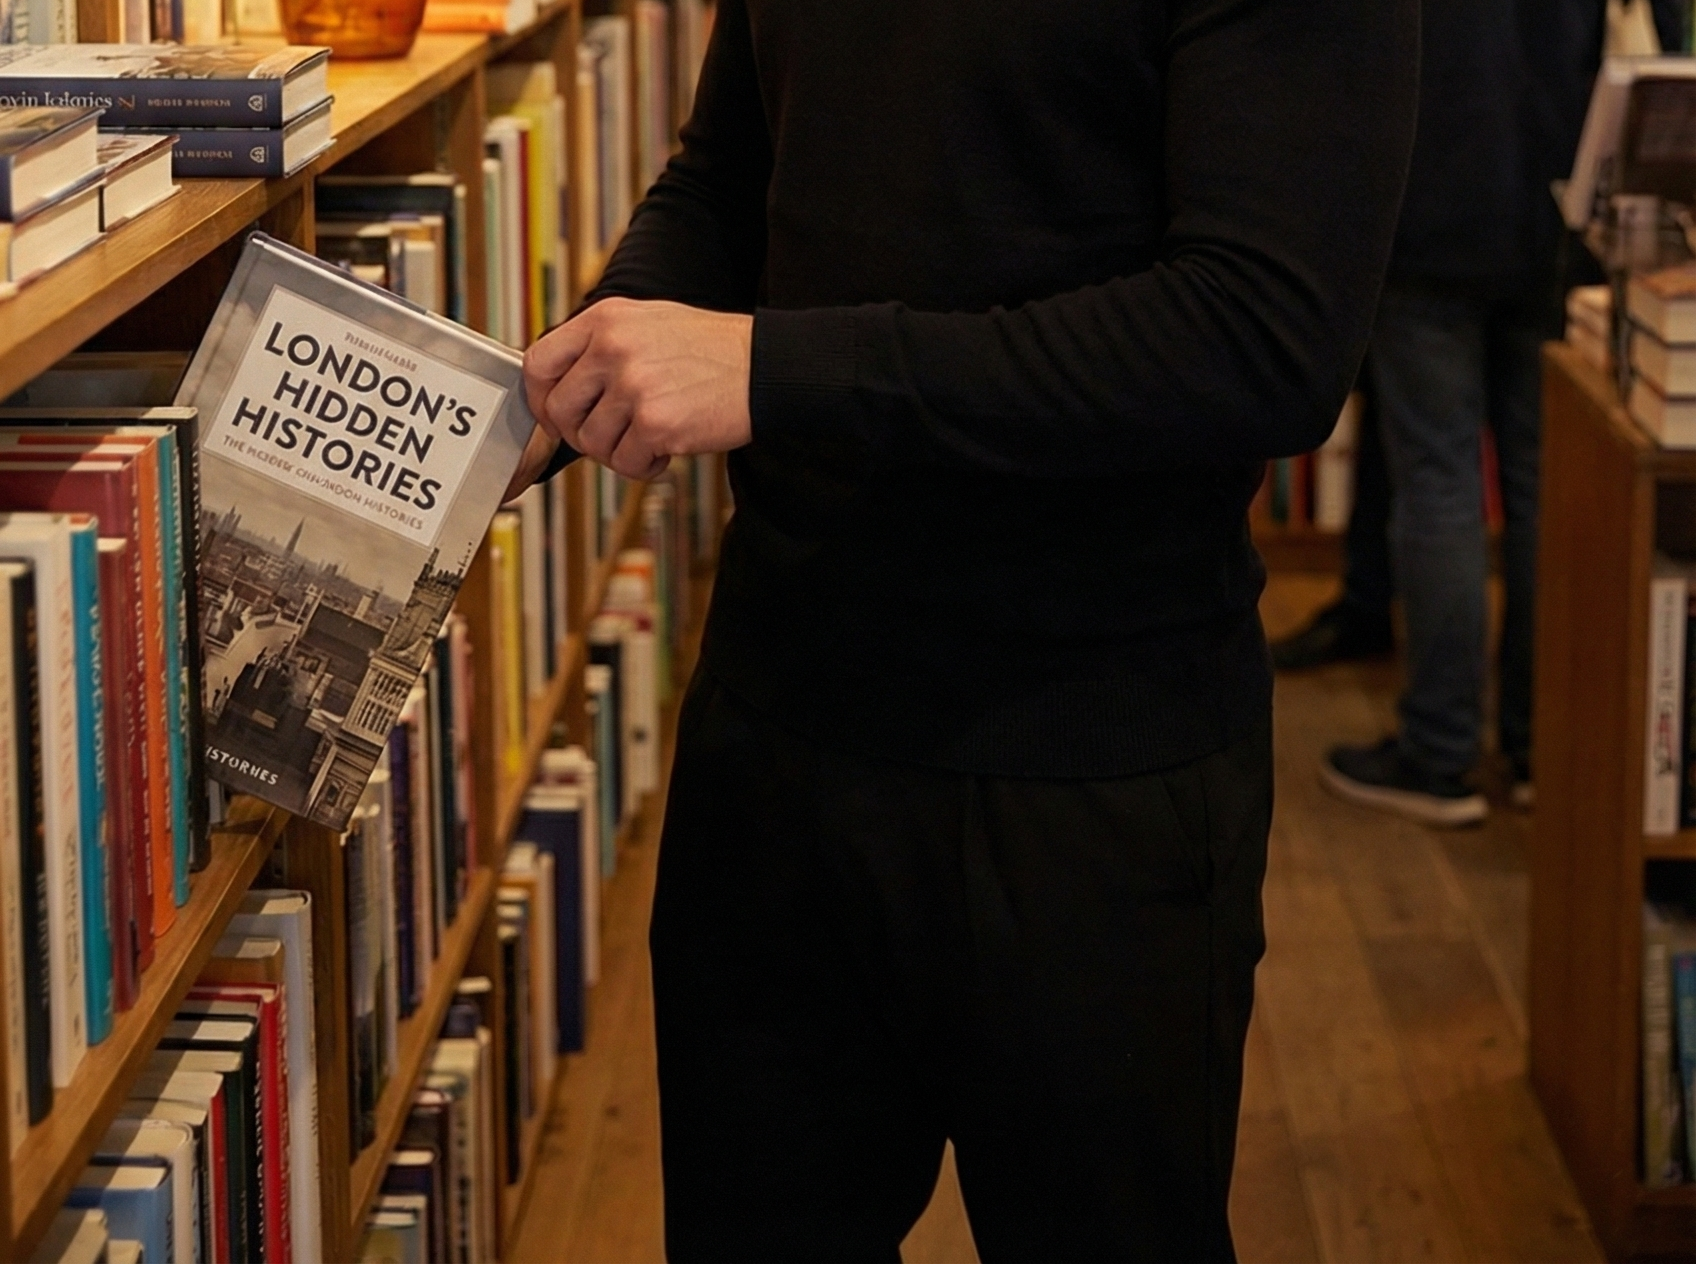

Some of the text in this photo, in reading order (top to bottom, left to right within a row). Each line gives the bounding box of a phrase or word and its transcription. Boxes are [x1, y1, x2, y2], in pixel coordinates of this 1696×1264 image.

[264, 321, 477, 437] LONDON'S
[273, 370, 434, 464] HIDDEN
[223, 435, 245, 452] THE
[231, 397, 442, 510] HISTORIES
